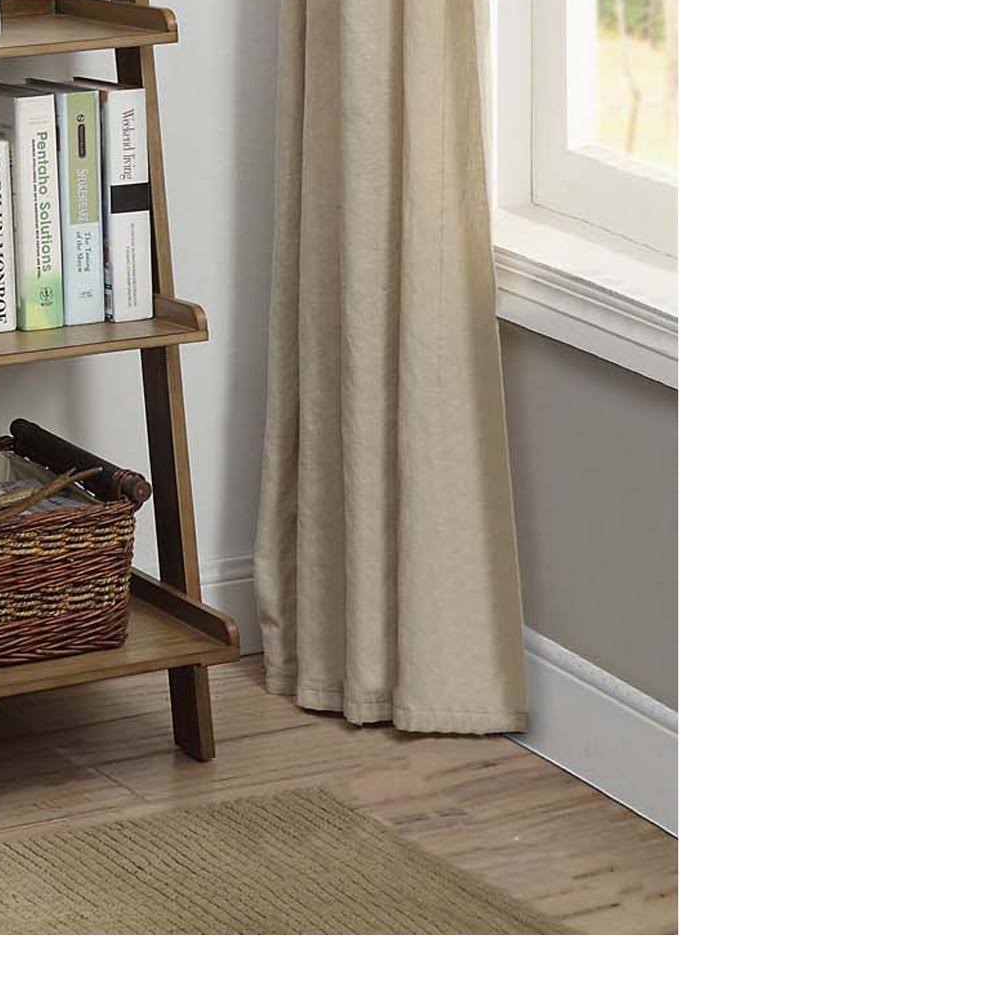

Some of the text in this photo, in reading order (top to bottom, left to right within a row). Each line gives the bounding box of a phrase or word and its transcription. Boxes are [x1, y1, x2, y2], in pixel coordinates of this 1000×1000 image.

[120, 108, 136, 180] Weekend living
[37, 131, 53, 272] Pentaho Solutions
